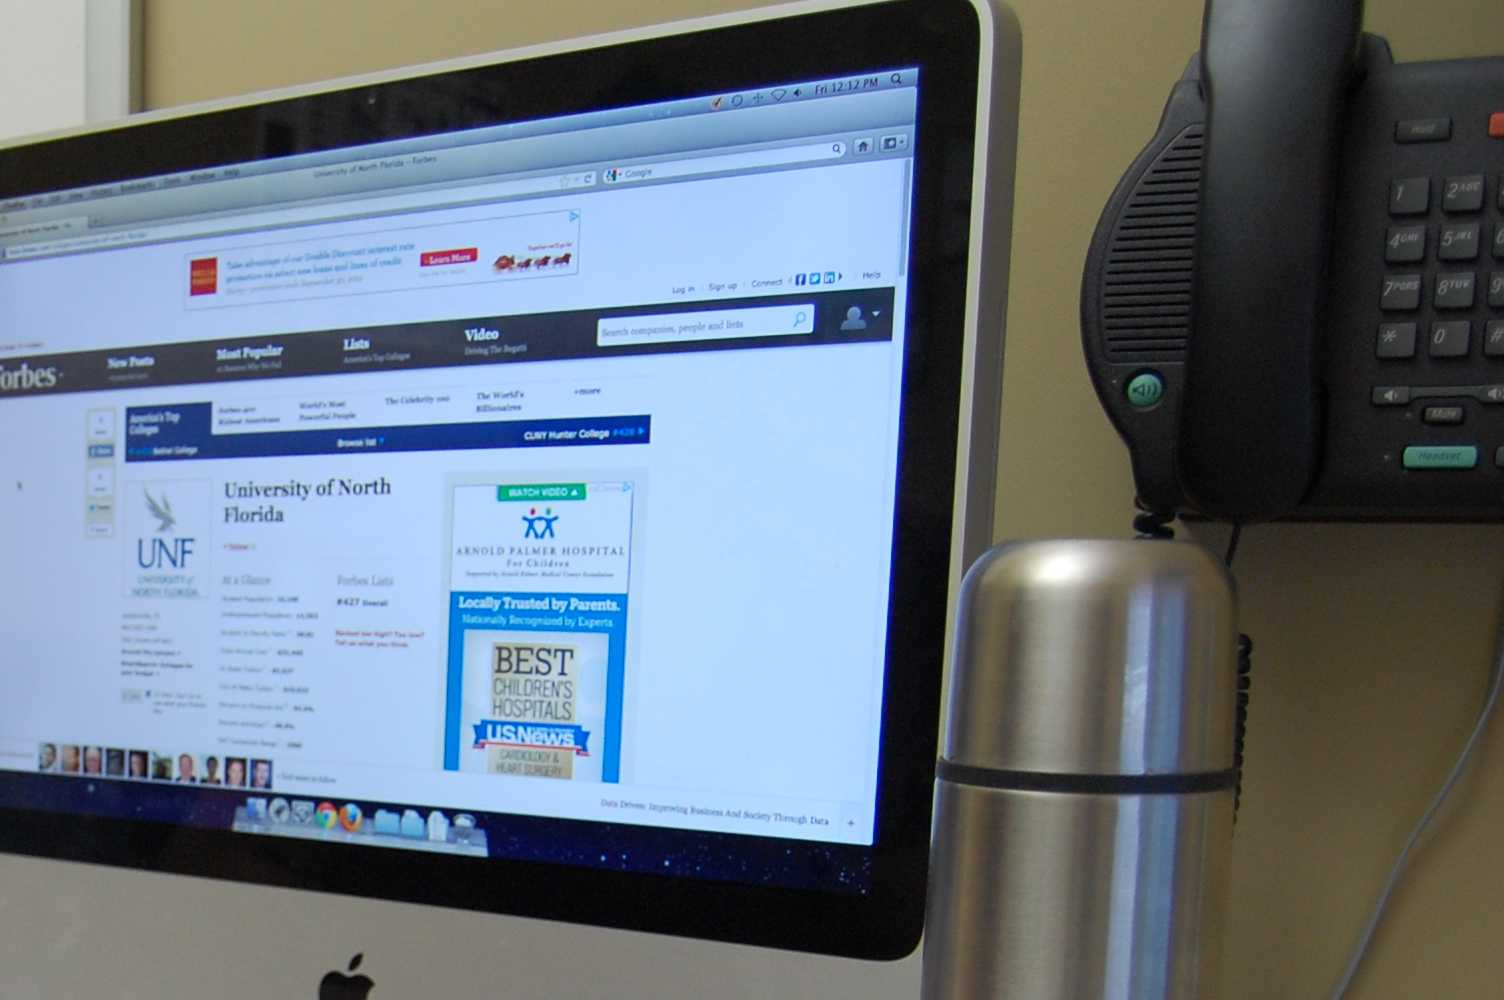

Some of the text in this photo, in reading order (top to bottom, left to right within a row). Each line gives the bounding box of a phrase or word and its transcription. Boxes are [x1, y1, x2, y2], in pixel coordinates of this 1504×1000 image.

[815, 77, 879, 95] Fri 12:12 PM
[625, 168, 652, 179] Google
[1396, 185, 1404, 200] 1
[429, 253, 471, 265] Learn More
[862, 271, 881, 280] Help
[708, 282, 725, 292] Sign
[751, 278, 783, 288] Connect
[672, 286, 686, 295] Log
[464, 327, 499, 342] Video
[601, 319, 744, 338] Search companies, people and lists
[1433, 328, 1445, 344] 0
[343, 337, 370, 351] Lists
[216, 344, 283, 360] Most Popular
[386, 351, 411, 362] Colleges
[107, 355, 155, 369] New Posts
[385, 396, 398, 405] The
[400, 394, 434, 406] Celebrity
[476, 389, 524, 400] The World's
[300, 400, 345, 410] World's Most
[476, 404, 522, 412] Billionaires
[164, 411, 180, 424] Top
[300, 411, 356, 421] Powerful People
[524, 428, 610, 441] CUNY Hunter College
[337, 436, 377, 448] Browse list
[1418, 452, 1461, 461] Headset
[224, 477, 392, 501] University of North
[508, 486, 568, 497] WATCH VIDEO
[223, 505, 284, 523] Florida
[137, 537, 194, 569] UNF
[456, 546, 625, 556] ARNOLD PALMER HOSPITAL
[506, 558, 570, 568] For Children
[337, 574, 369, 586] Forbes
[337, 598, 361, 606] #427
[458, 595, 621, 613] Locally Trusted by Parents.
[462, 614, 614, 629] Nationally Recognized by Experts
[494, 646, 574, 676] BEST
[492, 677, 573, 699] CHILDREN'S
[492, 700, 572, 721] HOSPITALS
[486, 724, 575, 746] USNews
[601, 798, 619, 808] Data
[648, 802, 689, 816] Improving
[691, 805, 724, 817] Business
[725, 808, 742, 818] And
[743, 810, 771, 822] Society
[773, 812, 807, 825] Through
[810, 815, 829, 826] Data
